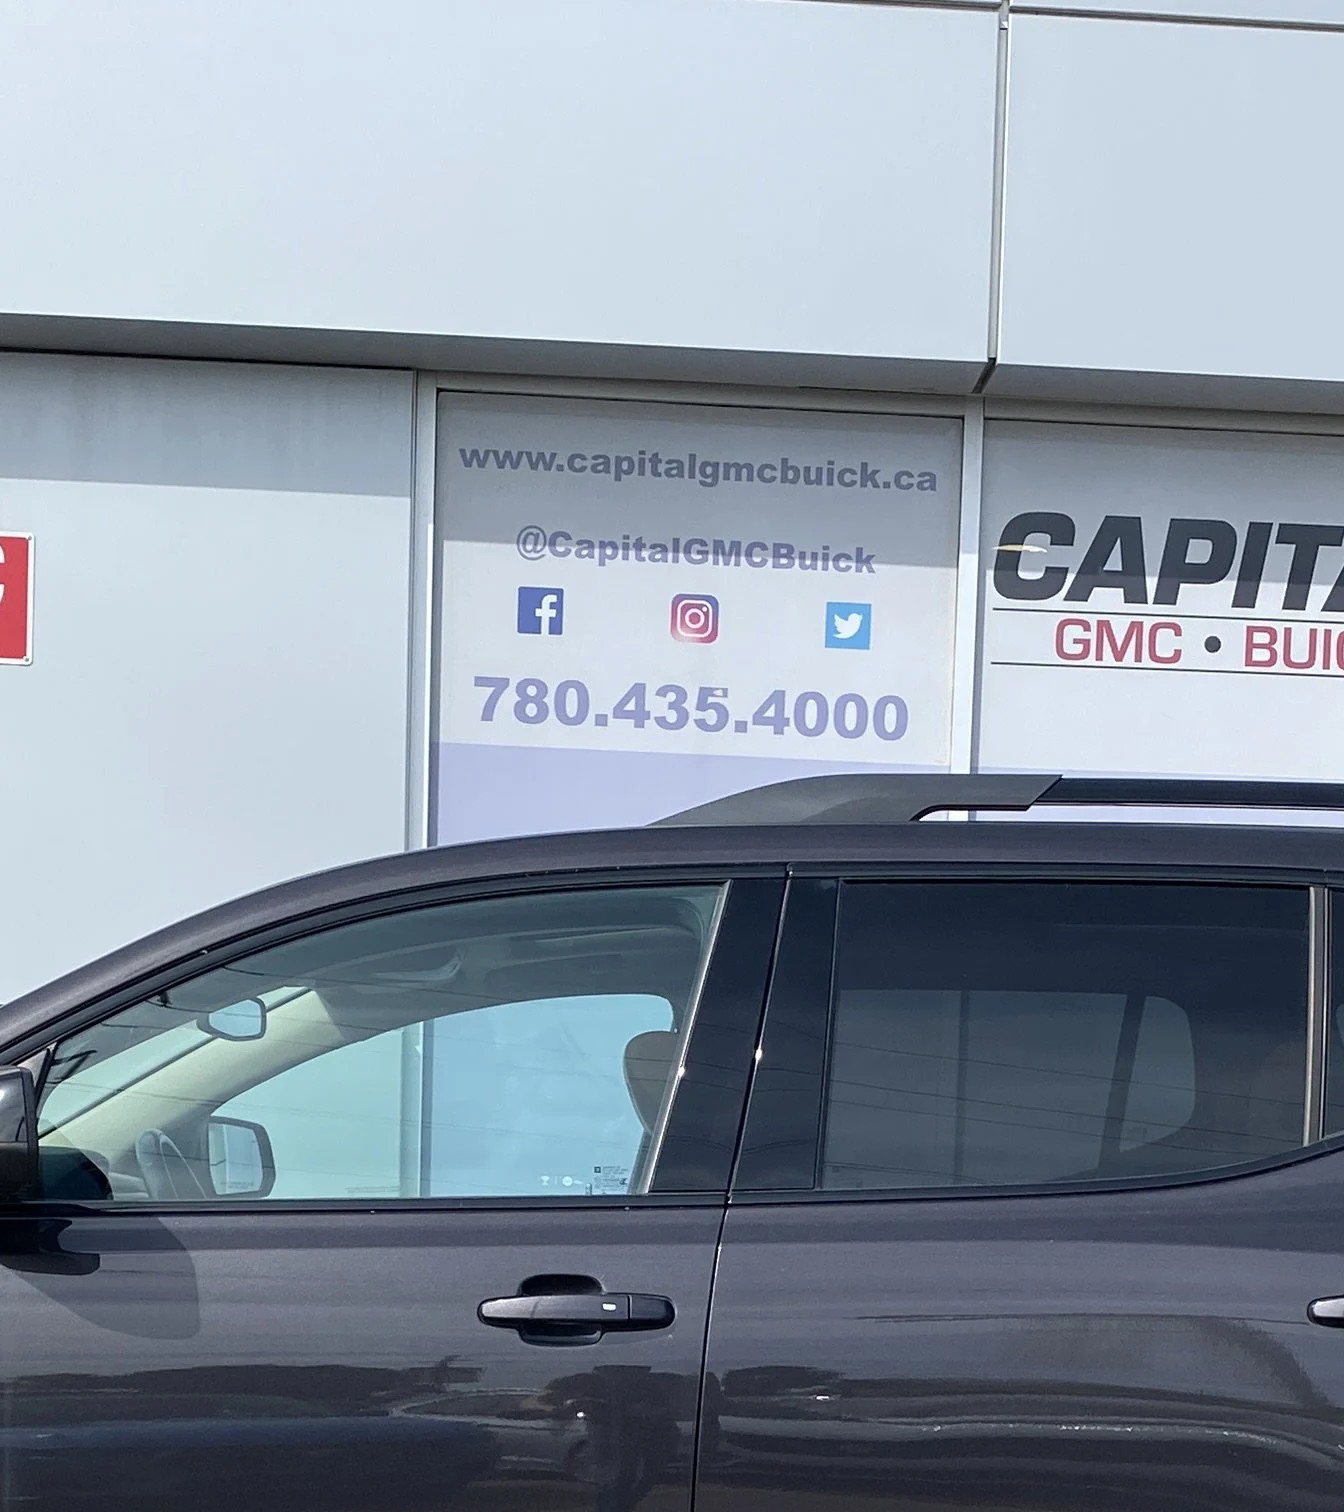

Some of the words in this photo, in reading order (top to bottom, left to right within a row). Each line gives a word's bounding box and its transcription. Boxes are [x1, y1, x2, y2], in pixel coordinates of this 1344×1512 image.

[459, 447, 937, 491] www.capitalgmcbuick.ca
[516, 524, 876, 574] @CapitalGMCBuick
[1055, 618, 1183, 664] GMC
[473, 676, 909, 741] 780.435.4000
